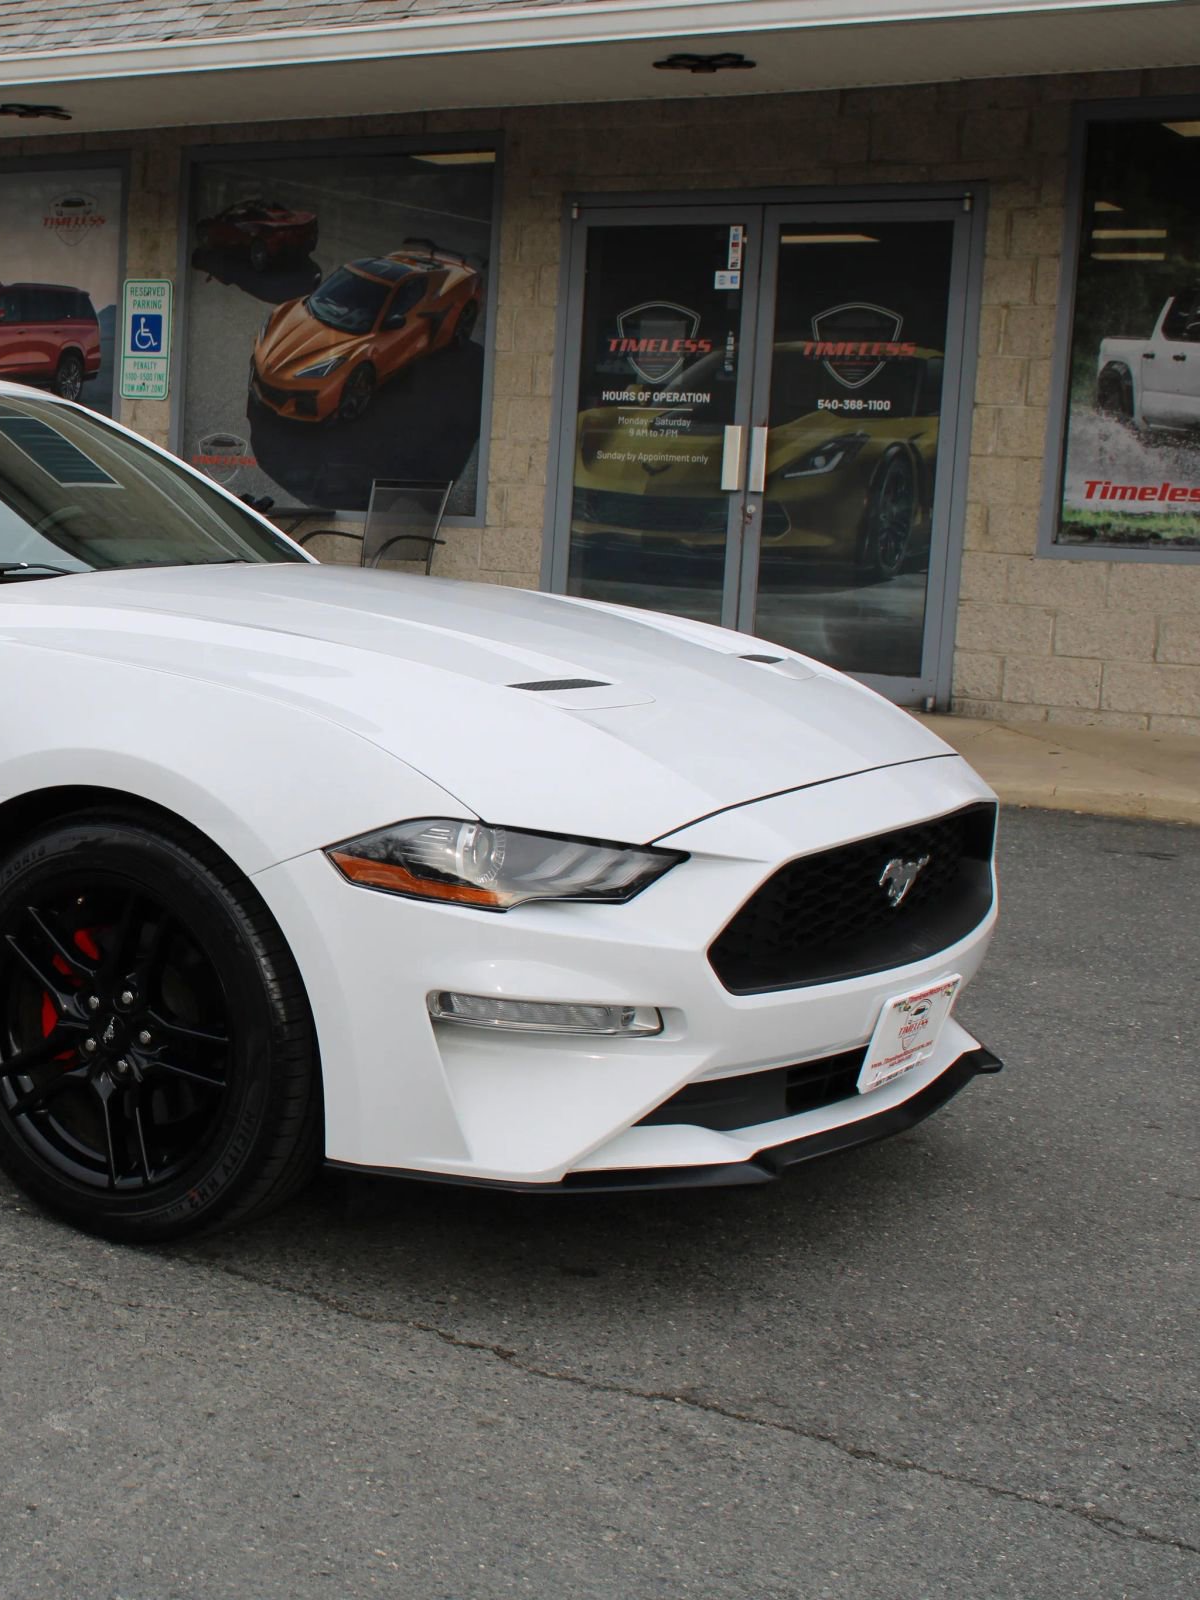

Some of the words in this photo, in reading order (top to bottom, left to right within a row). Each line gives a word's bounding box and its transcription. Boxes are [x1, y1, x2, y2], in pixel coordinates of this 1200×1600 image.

[130, 286, 166, 297] RESERVED
[133, 300, 162, 310] PARKING
[608, 338, 712, 353] TIMELESS
[803, 342, 917, 357] TIMELESS
[133, 360, 157, 370] PENALTY
[154, 372, 166, 382] FINE
[125, 383, 136, 393] TOW
[151, 383, 164, 393] ZONE
[602, 391, 636, 402] HOURS
[637, 391, 651, 402] OF
[653, 392, 711, 403] OPERATION
[817, 399, 891, 411] 540-368-1100
[618, 416, 650, 426] Monday
[655, 417, 692, 428] Saturday
[629, 429, 634, 437] 9
[636, 429, 648, 437] AM
[649, 429, 658, 437] to
[666, 429, 678, 438] PM
[596, 450, 625, 461] Sunday
[627, 451, 636, 462] by
[638, 452, 689, 464] Appointment
[691, 454, 709, 465] only
